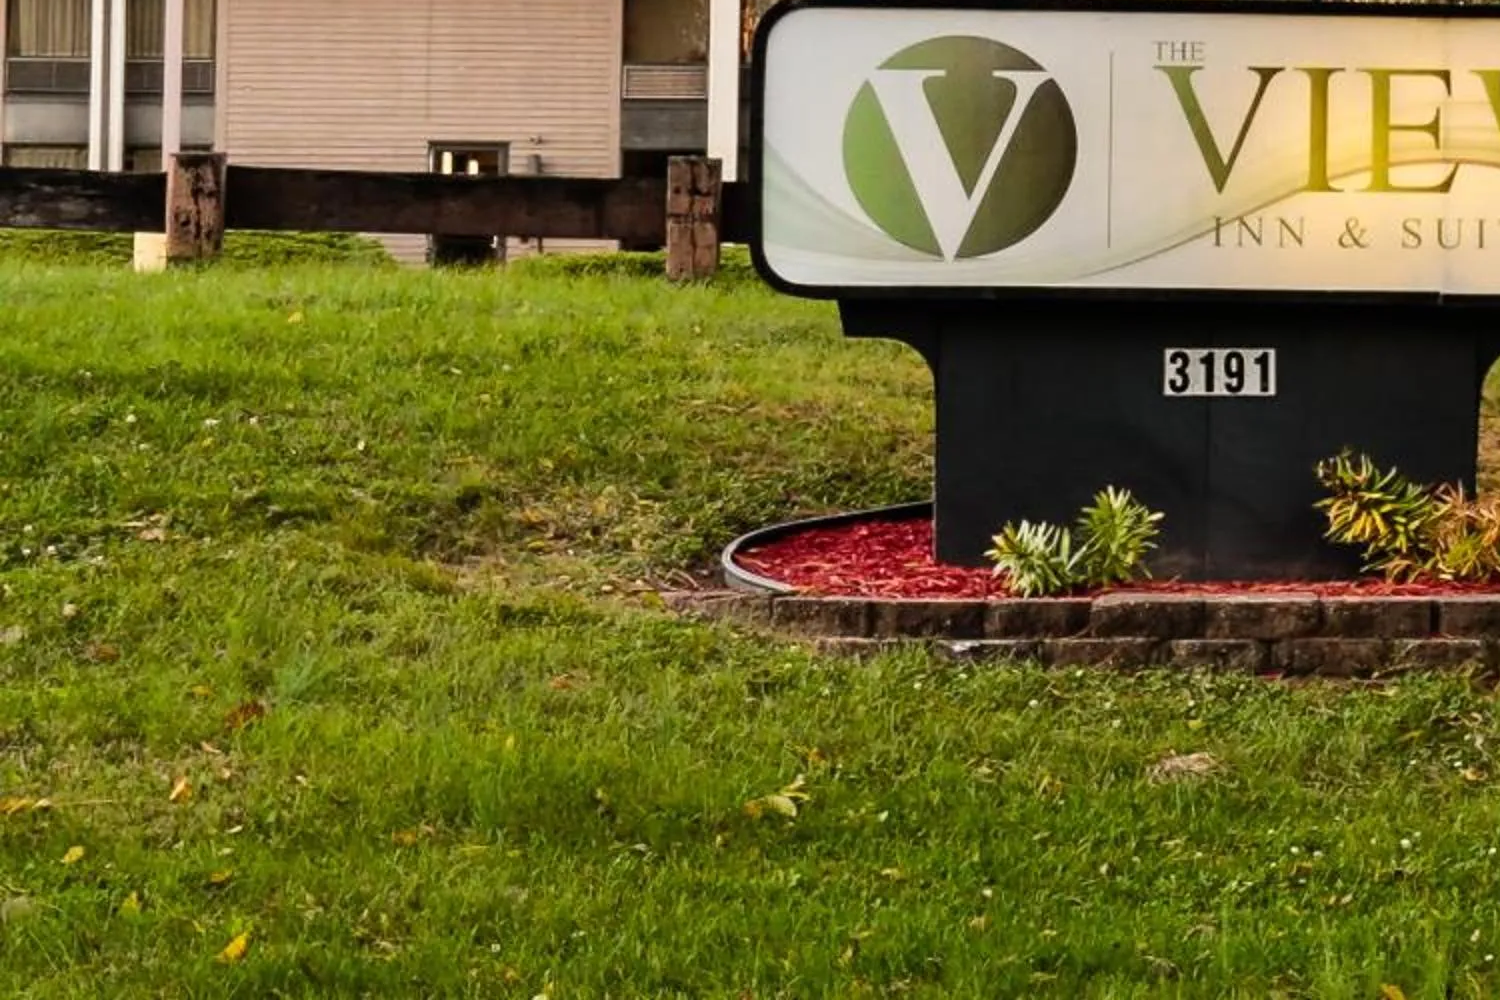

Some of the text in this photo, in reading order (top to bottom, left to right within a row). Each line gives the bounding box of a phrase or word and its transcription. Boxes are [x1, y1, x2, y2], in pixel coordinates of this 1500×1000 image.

[1154, 40, 1207, 63] THE
[865, 67, 1051, 262] V
[1213, 216, 1306, 249] INN
[1337, 217, 1368, 249] &
[1168, 350, 1272, 396] 3191
